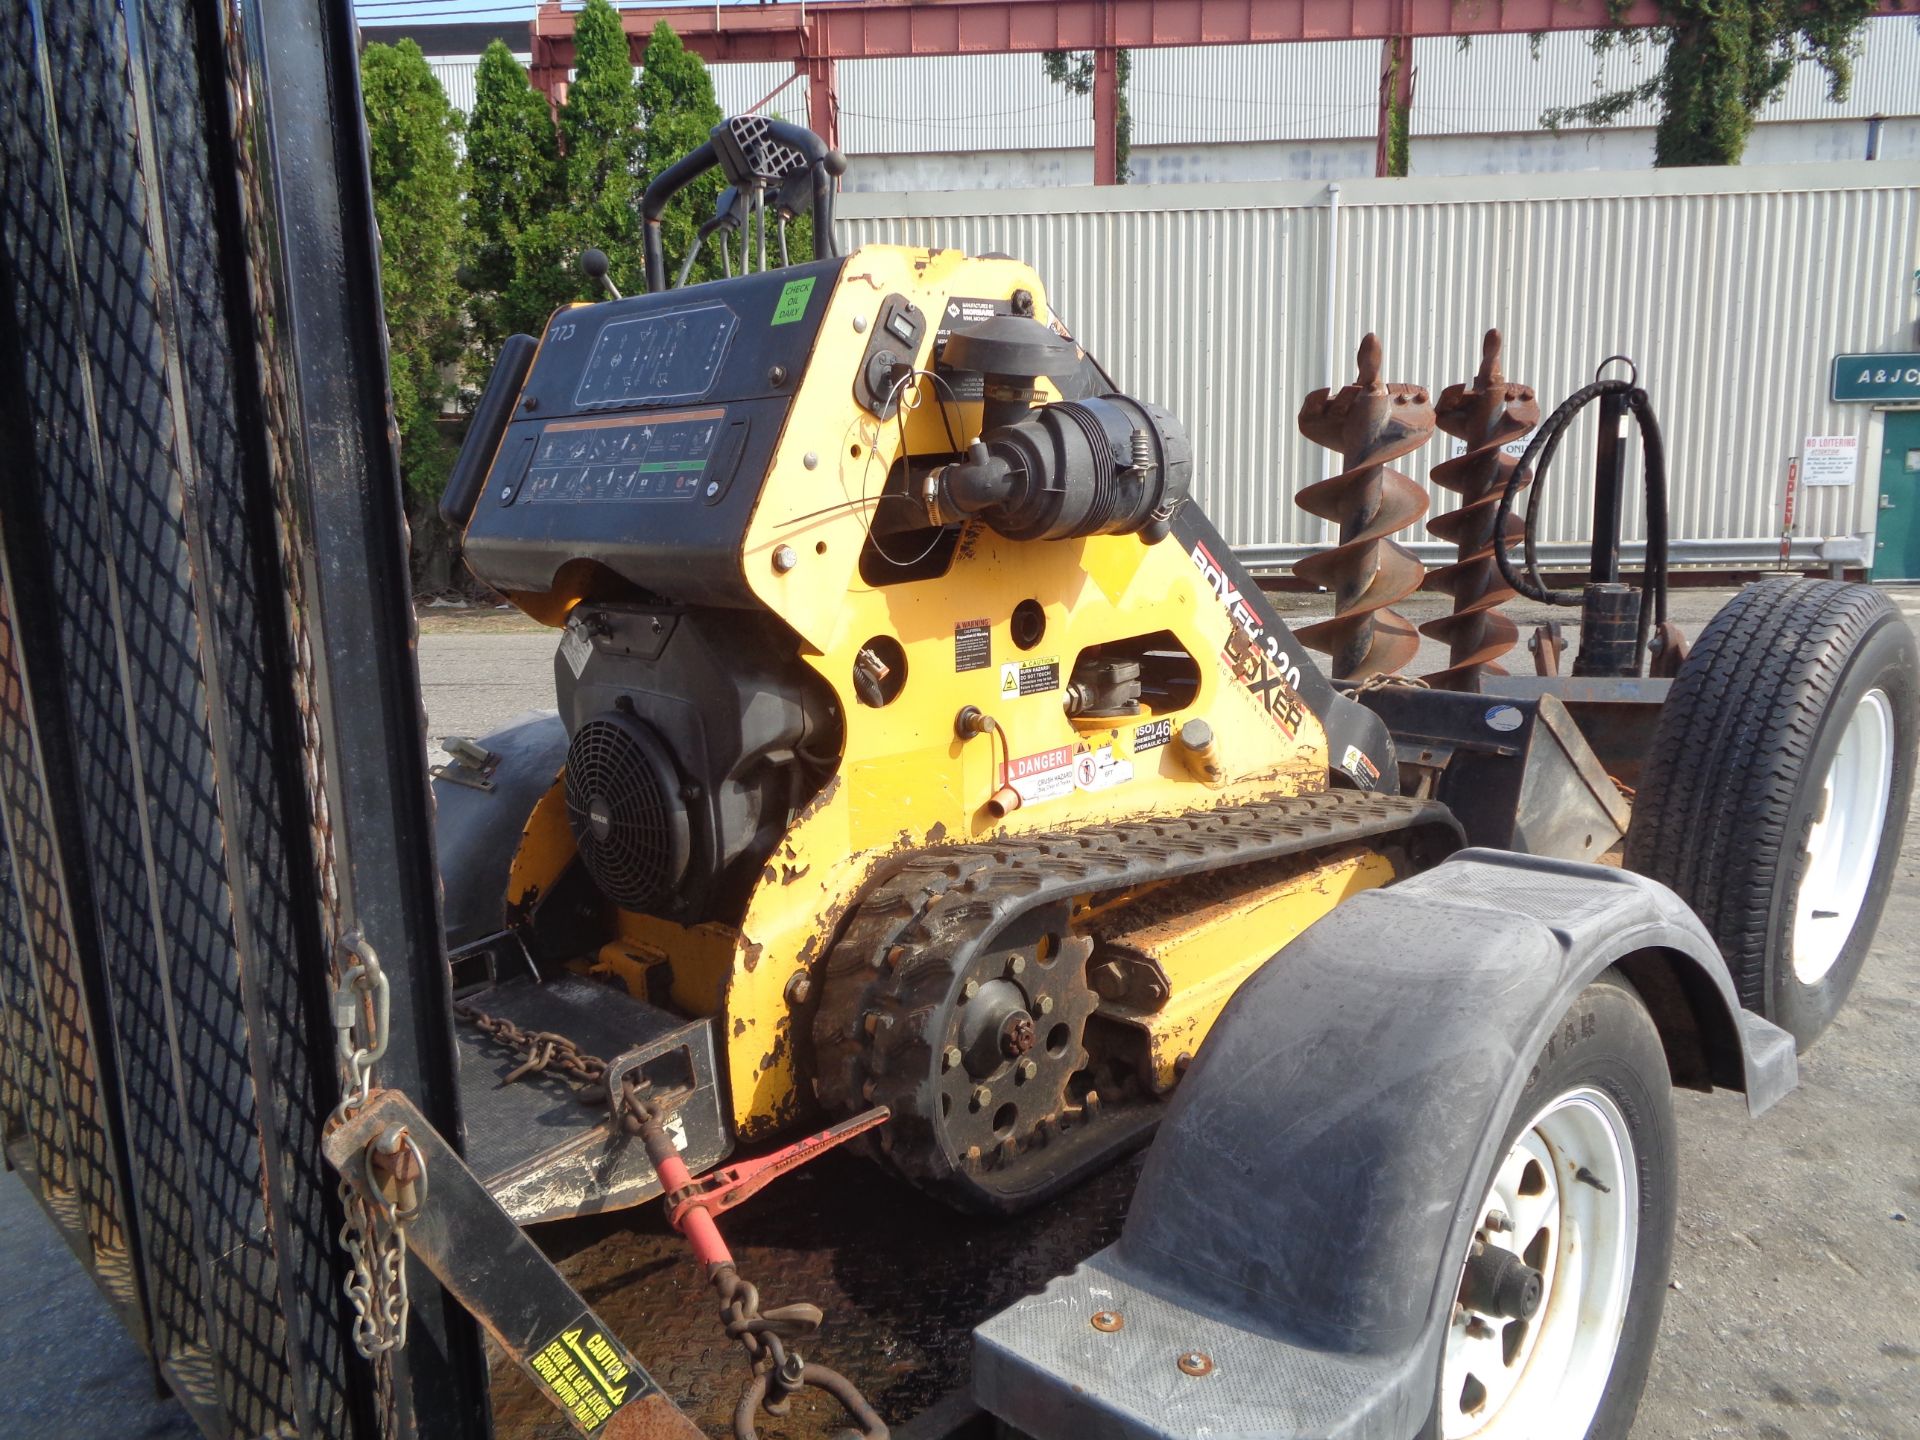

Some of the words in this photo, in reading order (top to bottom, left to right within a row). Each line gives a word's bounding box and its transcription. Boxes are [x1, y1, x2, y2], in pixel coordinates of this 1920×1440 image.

[785, 283, 811, 295] CHECK
[787, 296, 798, 306] OIL
[779, 308, 800, 318] DAILY
[1858, 370, 1870, 383] A
[1875, 369, 1886, 383] &
[1891, 369, 1901, 383] J
[1506, 445, 1526, 454] ONL
[962, 619, 989, 628] WARNING
[1028, 658, 1054, 666] CAUTION
[1156, 720, 1170, 737] 46
[1019, 750, 1066, 776] DANGER!
[1037, 777, 1053, 786] CRUSH
[1054, 771, 1072, 780] HAZARD
[586, 1333, 629, 1383] CAUTION
[546, 1342, 572, 1372] SECURE
[564, 1365, 581, 1382] ALL
[574, 1374, 593, 1396] GATE
[584, 1390, 613, 1421] LATCHES
[532, 1353, 560, 1384] BEFORE
[552, 1377, 580, 1407] MOVING
[574, 1401, 600, 1431] TRAILER
